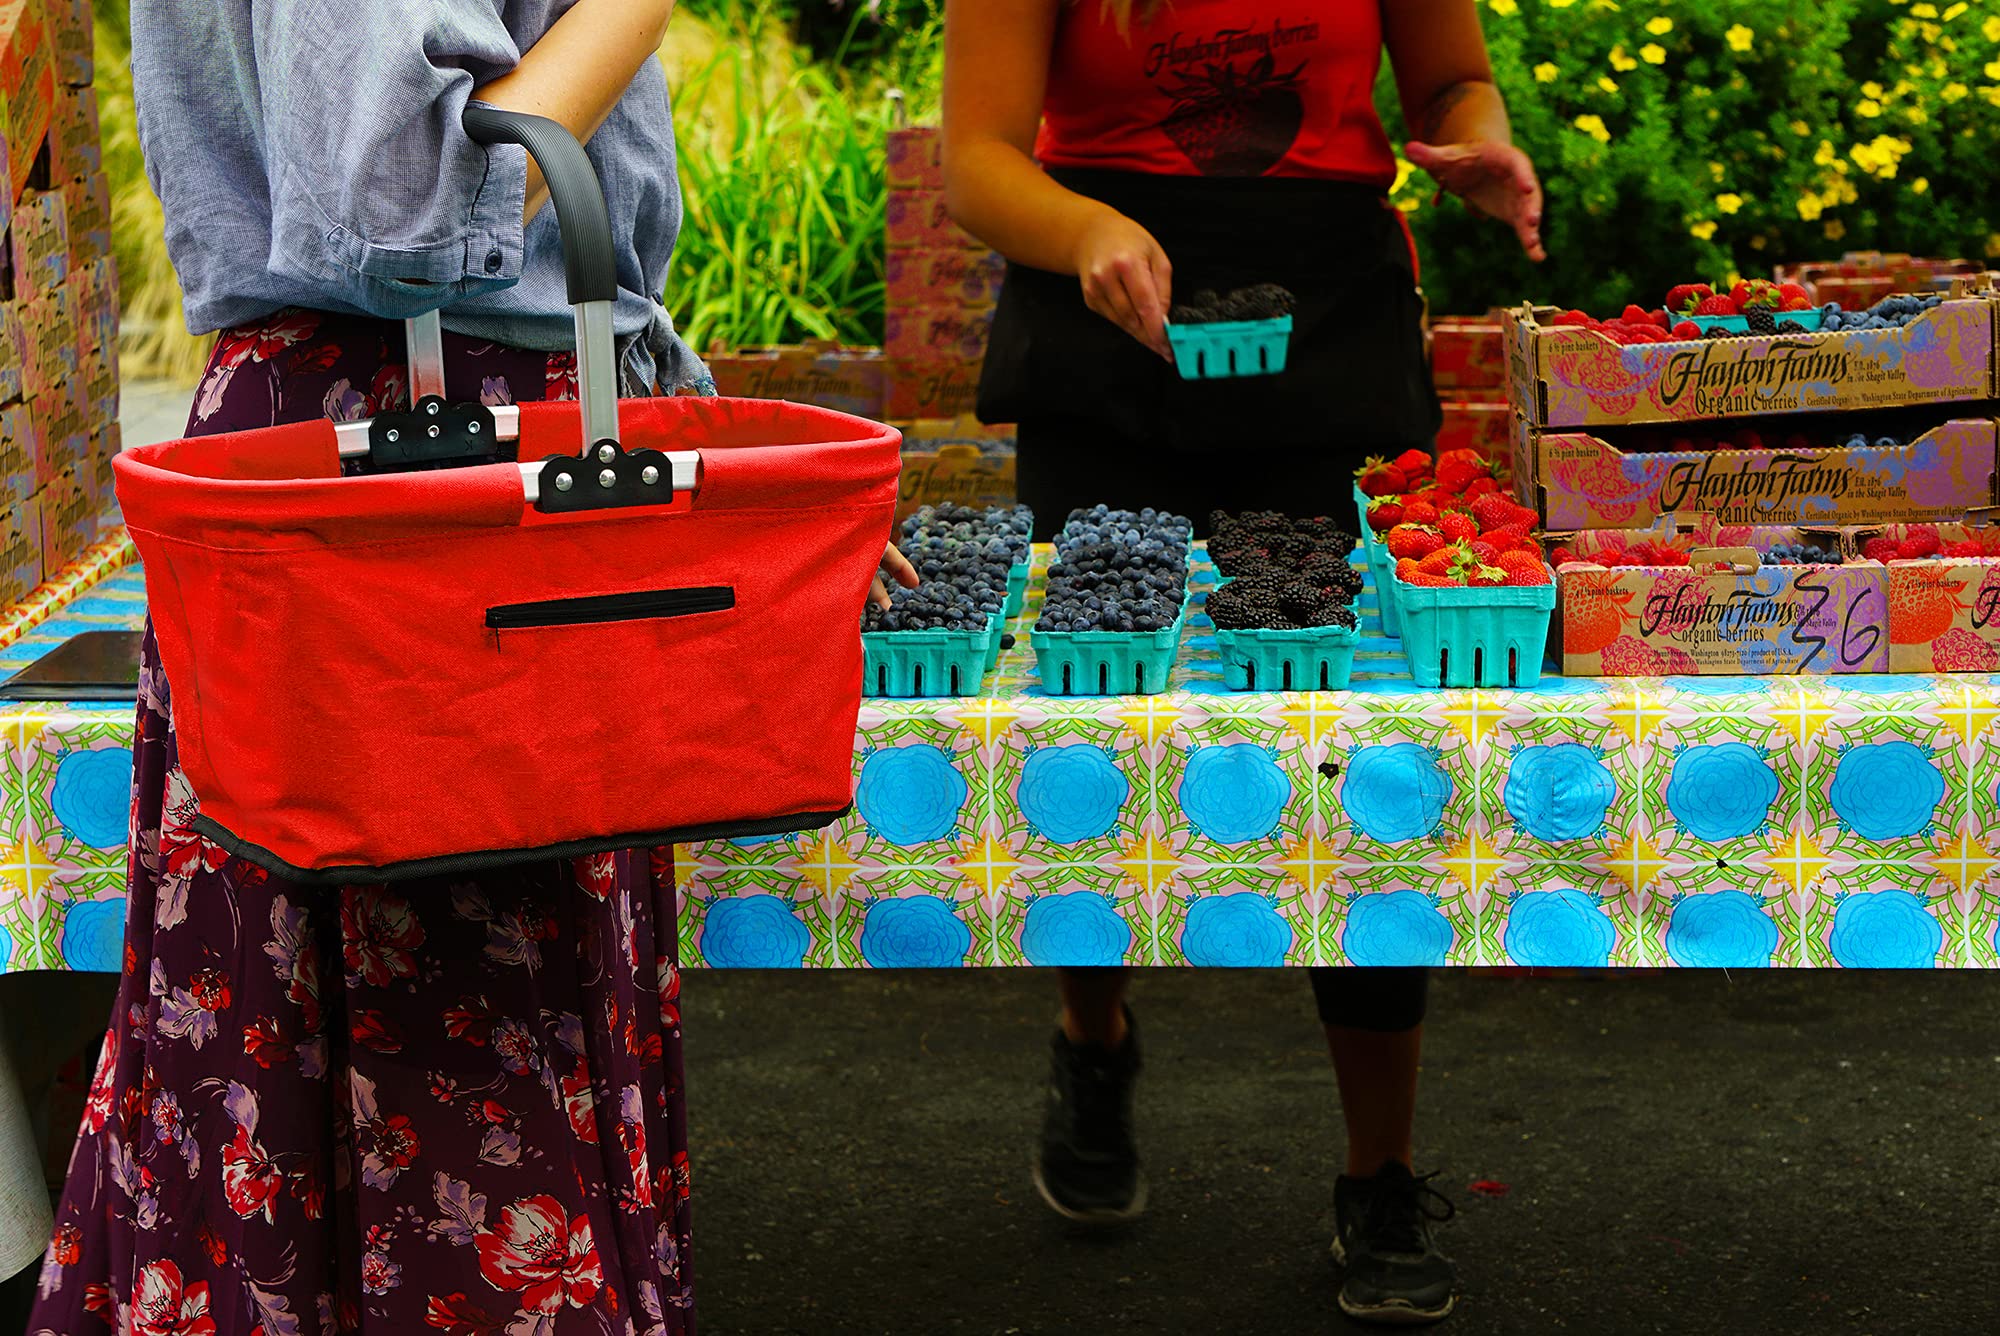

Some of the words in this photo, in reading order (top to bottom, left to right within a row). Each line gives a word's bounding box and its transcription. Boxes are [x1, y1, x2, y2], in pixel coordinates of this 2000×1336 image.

[1576, 340, 1599, 352] baskets
[1660, 341, 1776, 406] Hayton
[1908, 389, 1939, 401] Department
[1695, 388, 1758, 418] Organic
[1761, 393, 1798, 412] berries
[1561, 447, 1575, 462] pint
[1576, 447, 1600, 458] baskets
[1660, 451, 1777, 512] Hayton
[1855, 487, 1864, 498] the
[1761, 504, 1798, 521] berries
[1908, 507, 1939, 519] Department
[1592, 586, 1605, 600] pint
[1606, 585, 1629, 596] baskets
[1639, 584, 1735, 638] Hayton
[1682, 623, 1721, 649] organic
[1726, 621, 1764, 642] berries
[1691, 648, 1719, 660] Washington
